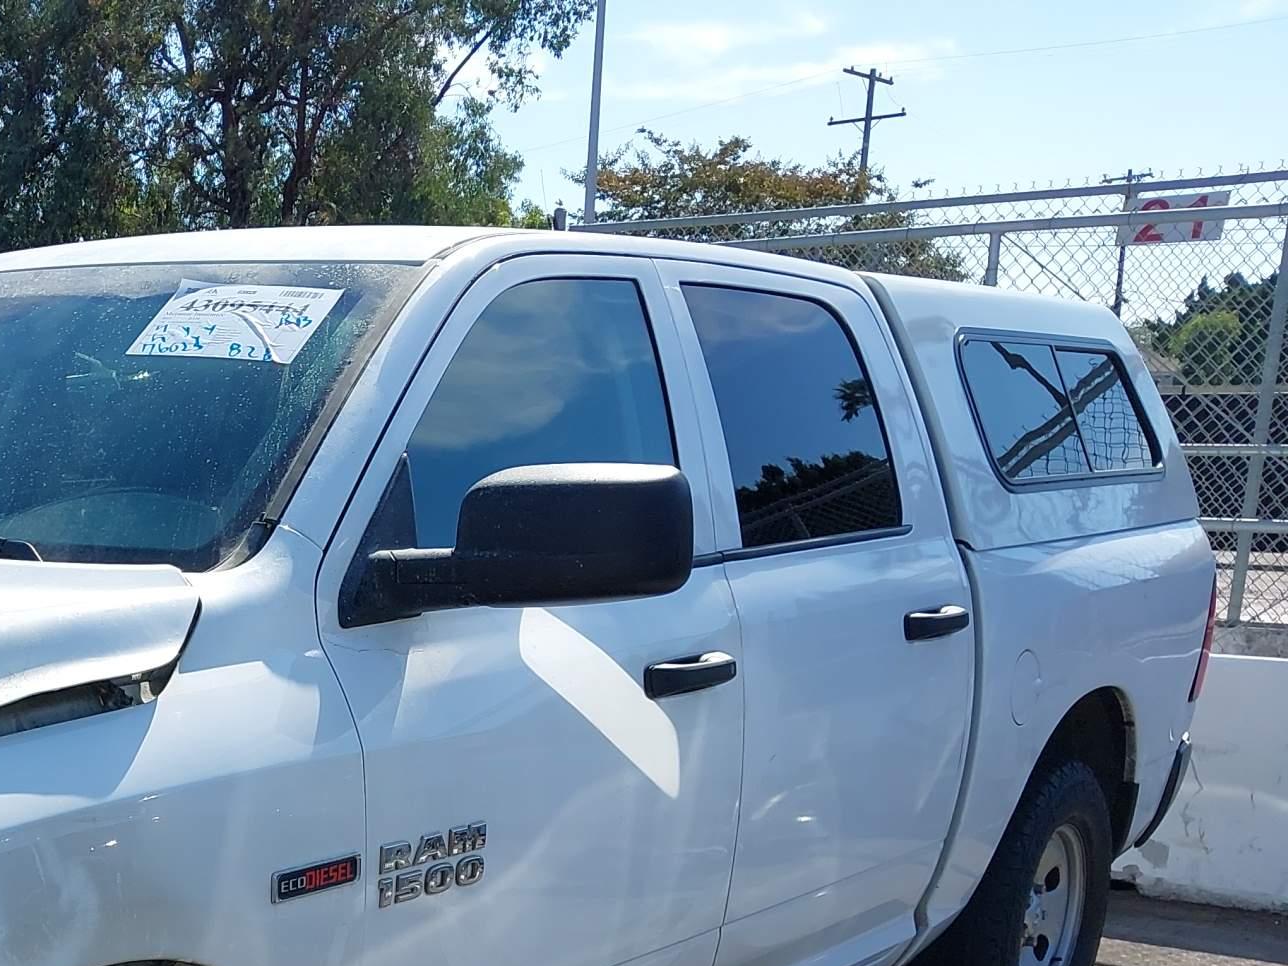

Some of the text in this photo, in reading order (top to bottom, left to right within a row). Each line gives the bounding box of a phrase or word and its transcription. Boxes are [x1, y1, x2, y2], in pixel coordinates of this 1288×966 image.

[1134, 195, 1209, 242] 21
[379, 821, 487, 875] RAM
[280, 862, 354, 894] ECODIESEL
[378, 854, 485, 909] 1500
